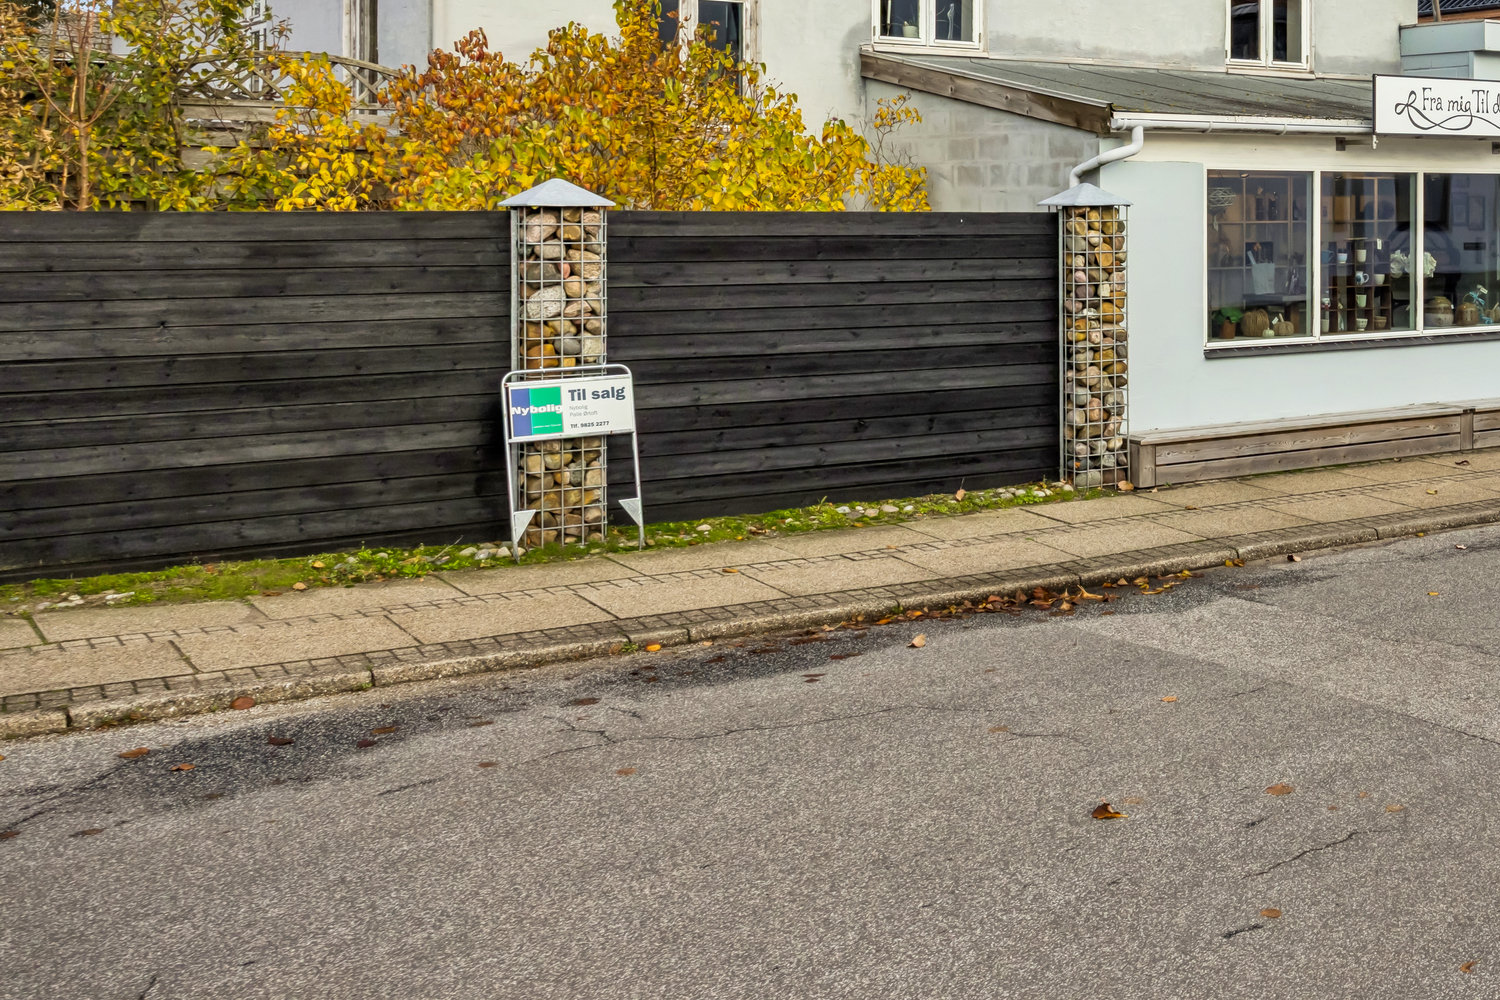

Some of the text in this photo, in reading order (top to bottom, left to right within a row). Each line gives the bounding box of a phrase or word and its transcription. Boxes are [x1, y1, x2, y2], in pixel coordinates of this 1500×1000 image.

[1422, 87, 1443, 111] Fra
[1447, 95, 1473, 121] mig
[1471, 89, 1490, 114] Til
[568, 386, 626, 401] Til salg
[511, 404, 563, 416] Nybolig
